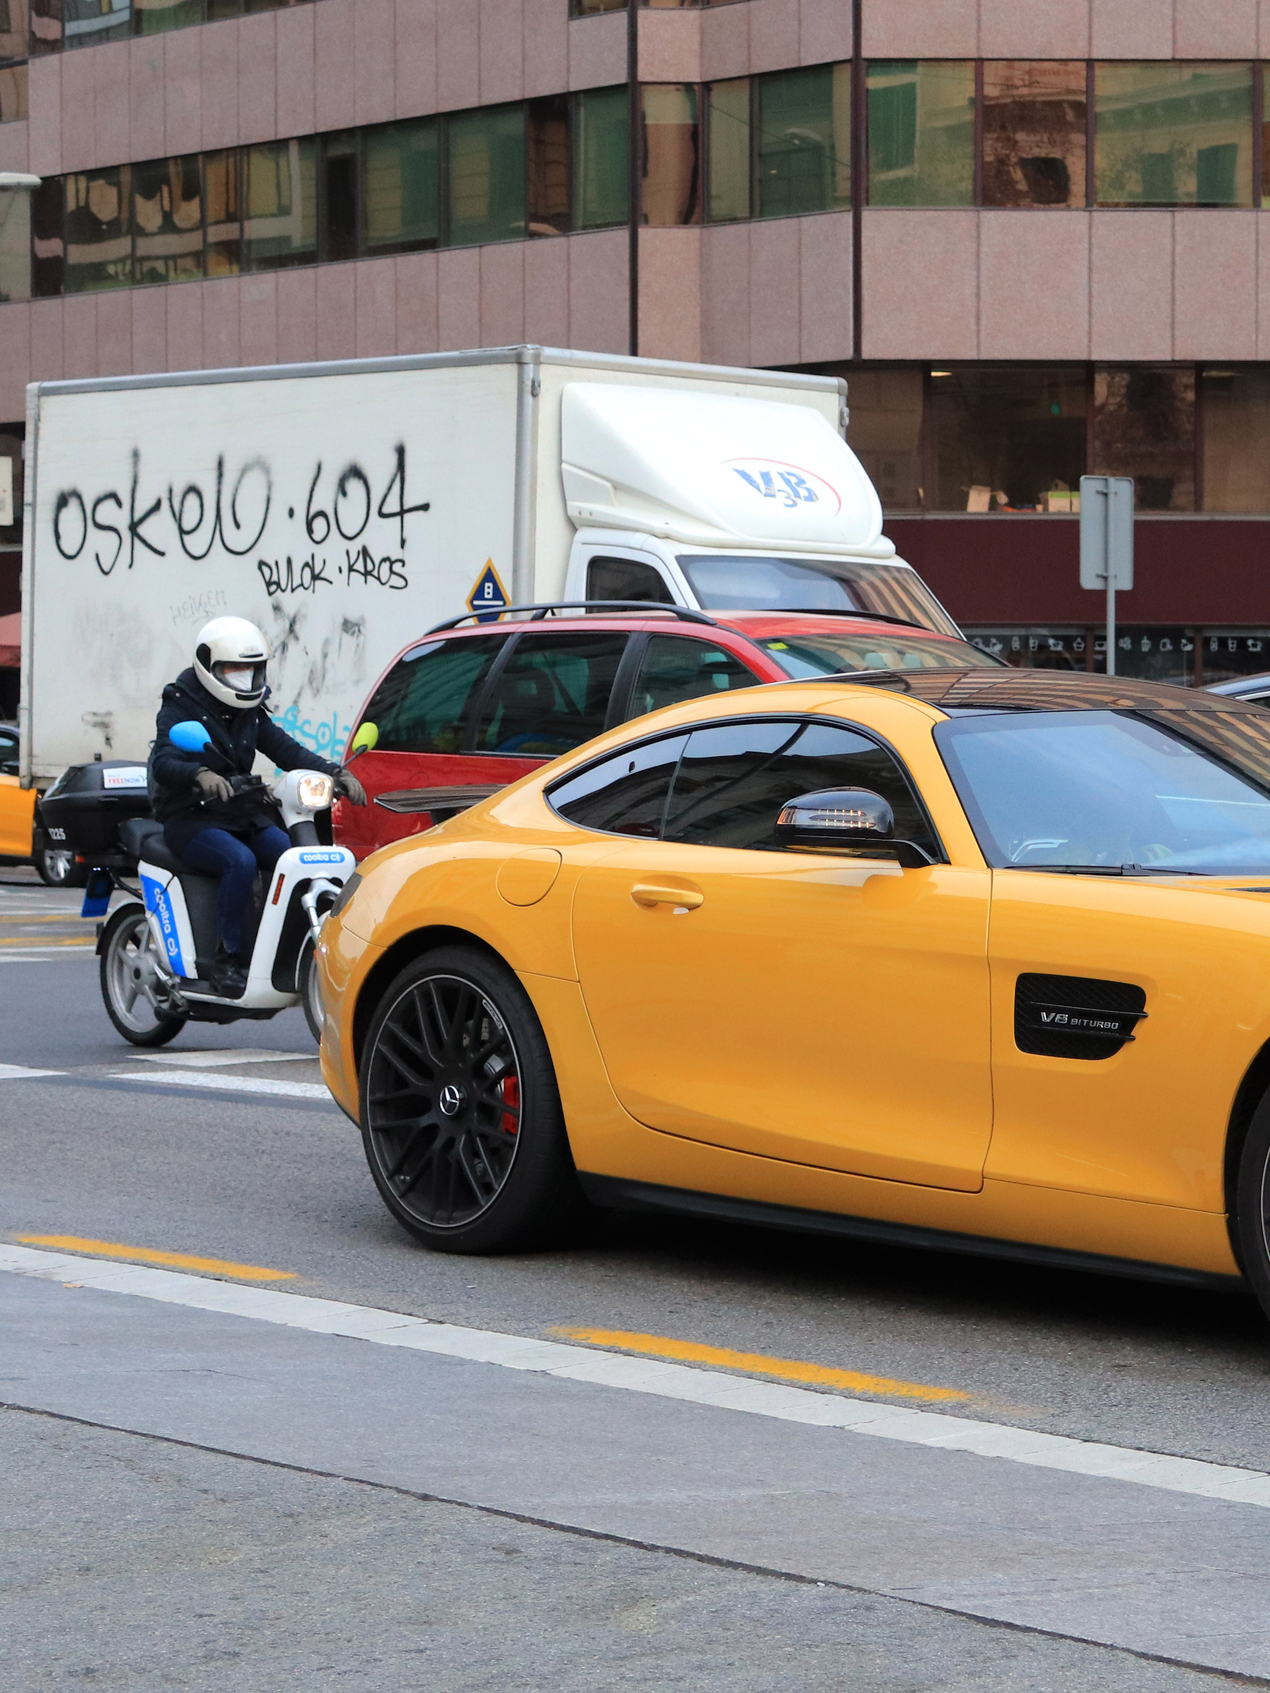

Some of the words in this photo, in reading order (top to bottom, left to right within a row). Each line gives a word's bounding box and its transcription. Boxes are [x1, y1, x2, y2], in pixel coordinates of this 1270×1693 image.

[154, 887, 171, 934] cooltra
[1040, 1011, 1069, 1025] V8
[1070, 1017, 1119, 1030] BITURBO
